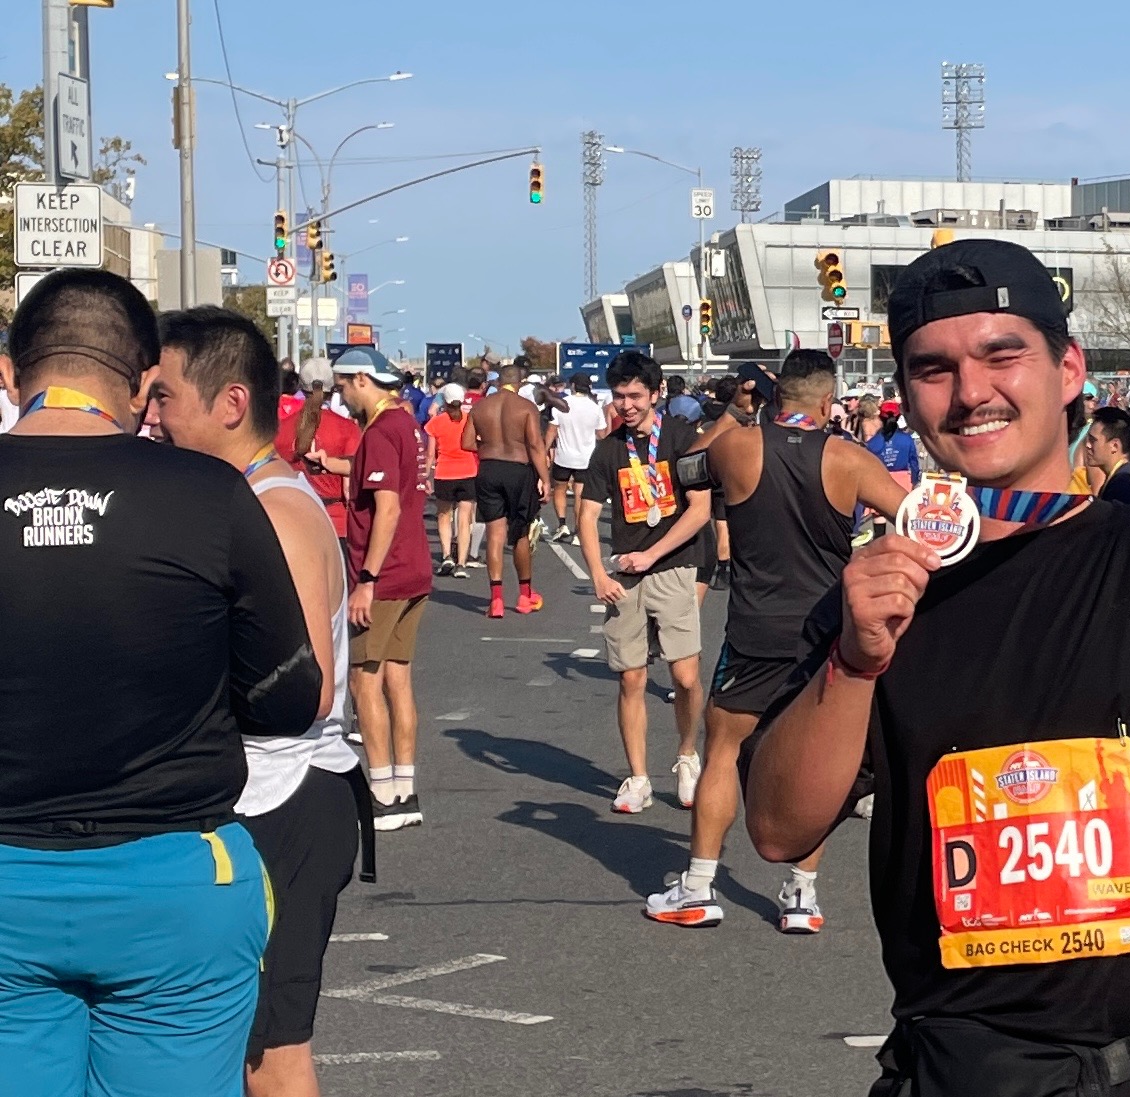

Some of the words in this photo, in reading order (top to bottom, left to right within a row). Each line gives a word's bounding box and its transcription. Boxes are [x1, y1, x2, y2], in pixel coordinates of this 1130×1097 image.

[67, 86, 79, 106] ALL
[62, 113, 85, 138] TRAFFIC
[36, 193, 80, 210] KEEP
[694, 205, 712, 216] 30
[19, 217, 98, 234] INTERSECTION
[31, 240, 87, 258] CLEAR
[4, 487, 65, 517] BOOGIE
[65, 488, 115, 517] DOWN
[33, 506, 84, 526] BRONX
[23, 524, 94, 547] RUNNERS
[938, 521, 963, 536] ISLAND
[998, 770, 1025, 788] STATEN
[1026, 769, 1056, 782] ISLAND
[945, 840, 977, 888] D
[998, 818, 1113, 884] 2540
[966, 942, 996, 957] BAG
[1000, 938, 1054, 954] CHECK
[1060, 928, 1105, 955] 2540
